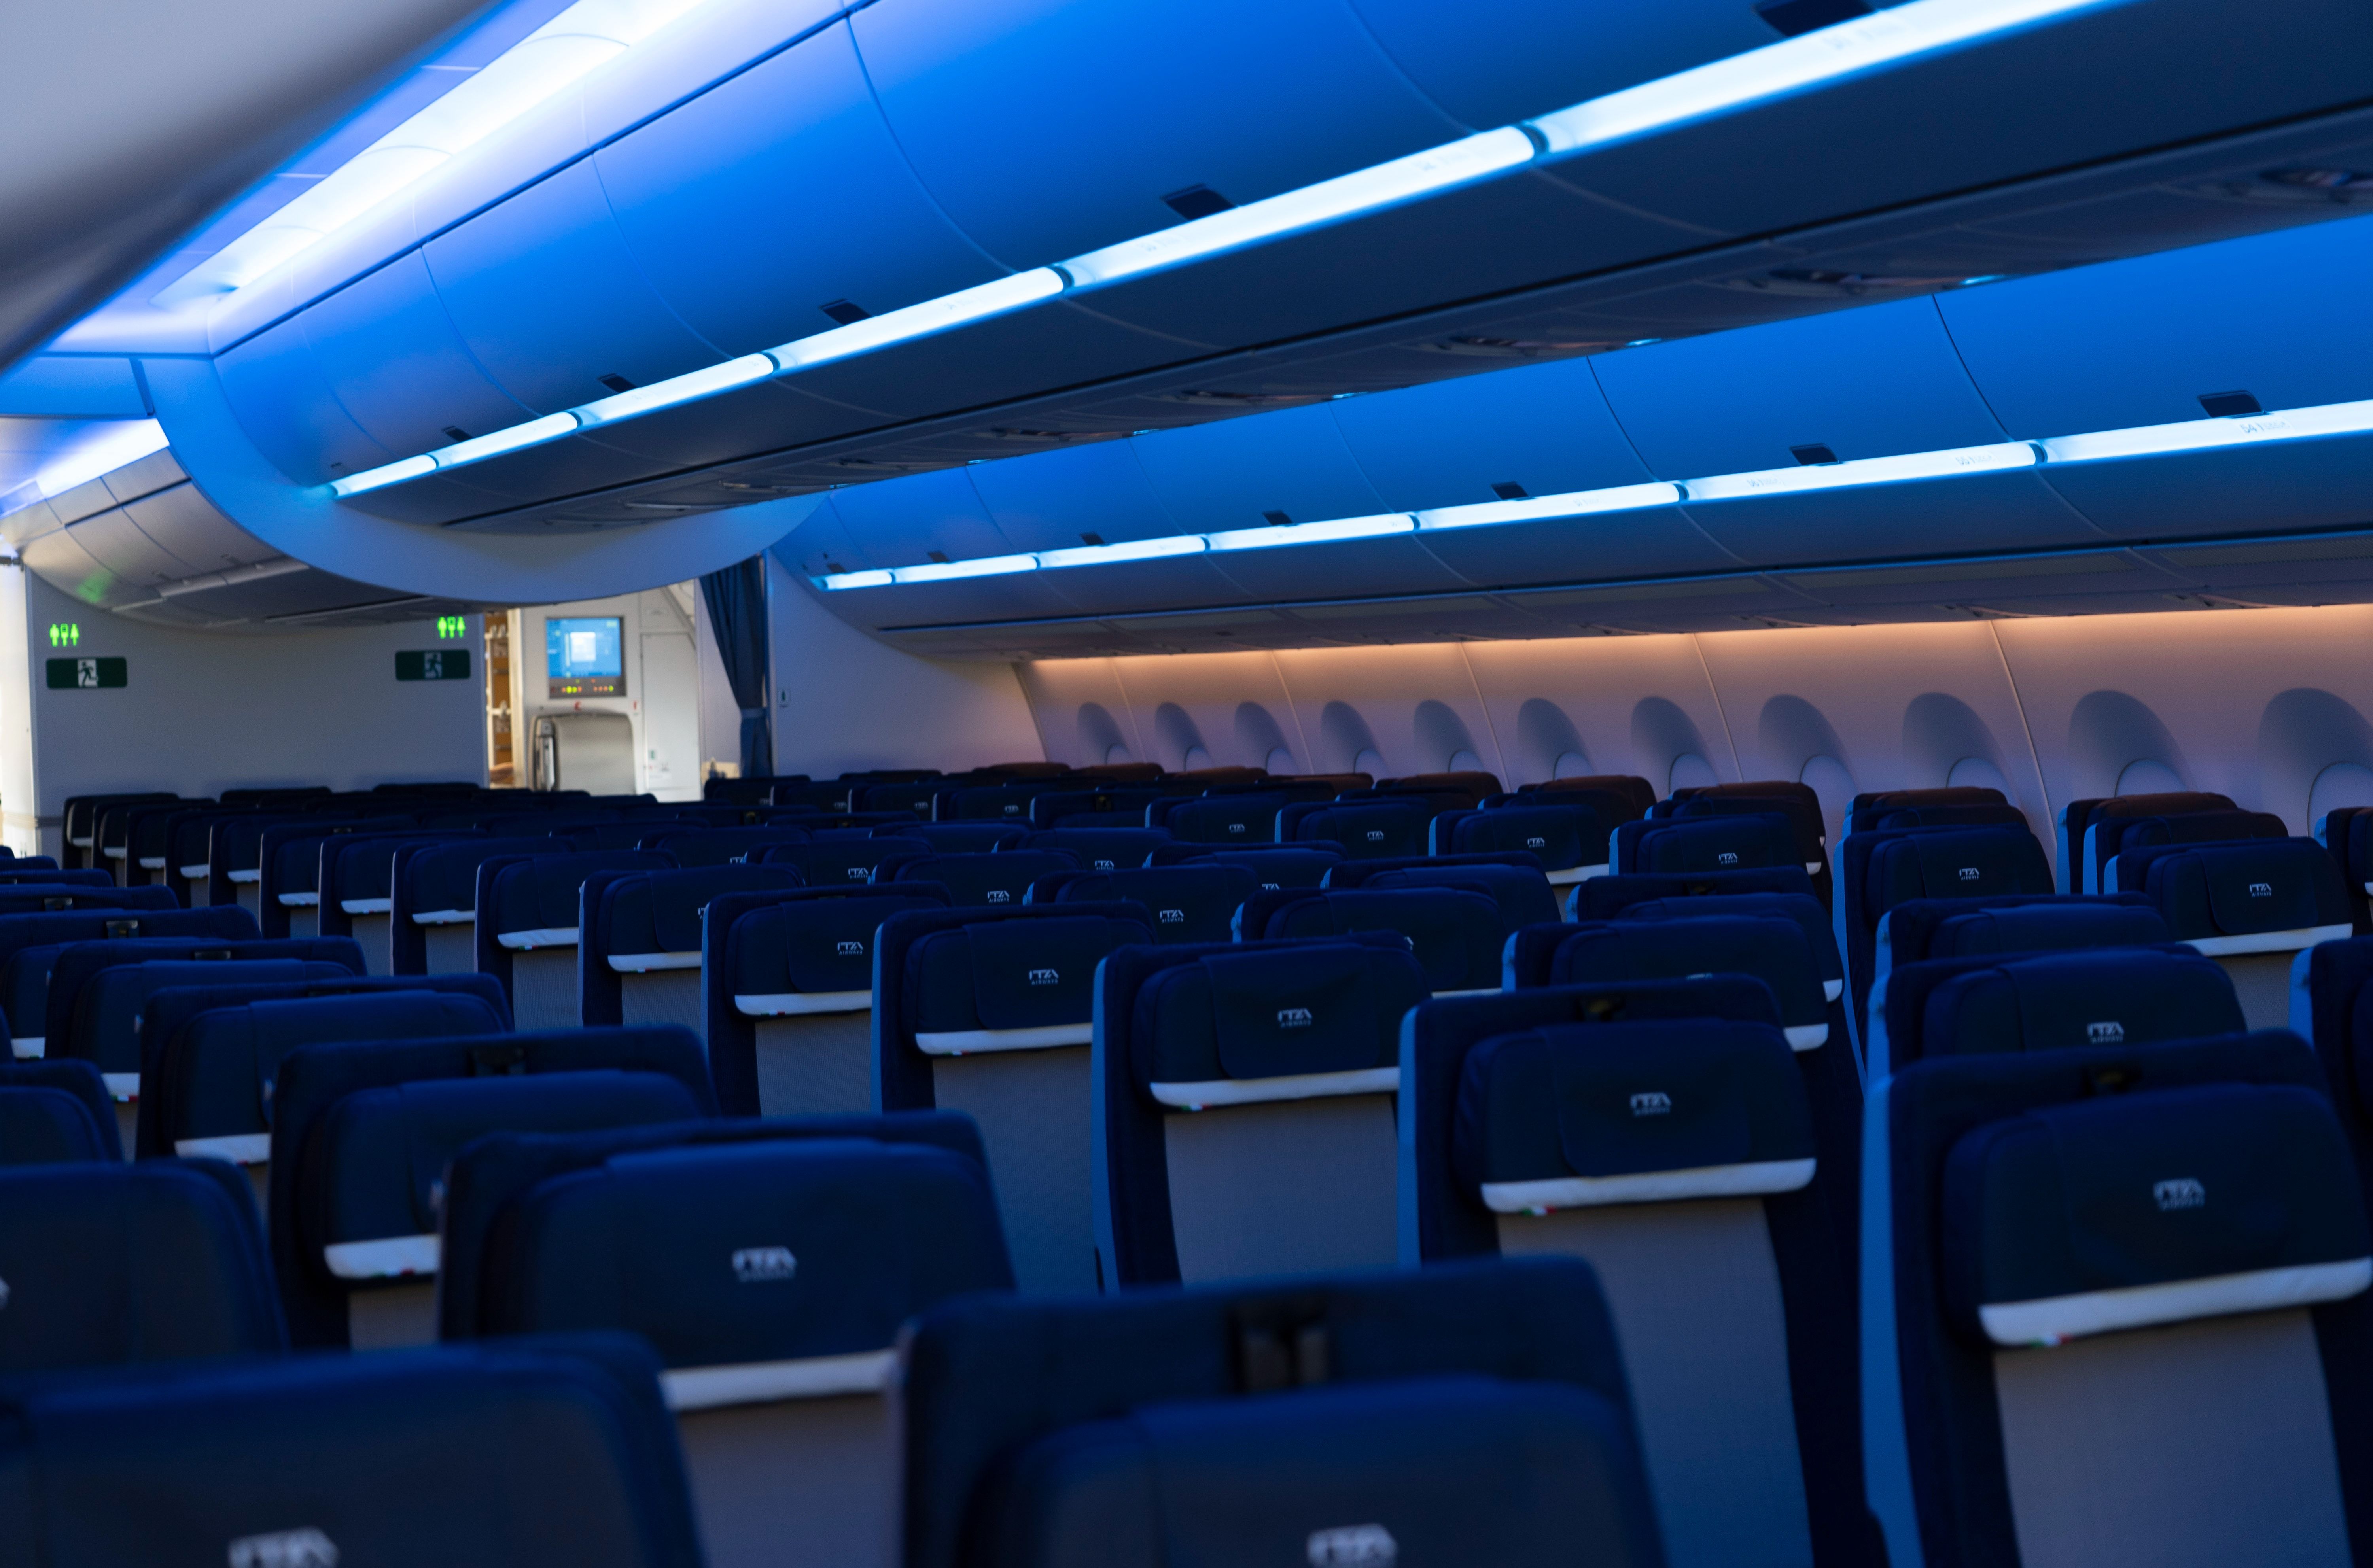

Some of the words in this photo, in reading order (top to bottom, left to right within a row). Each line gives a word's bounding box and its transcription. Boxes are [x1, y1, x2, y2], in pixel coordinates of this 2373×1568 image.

[1719, 853, 1738, 861] ITA
[1959, 868, 1979, 877] ITA
[2250, 883, 2271, 893] ITA
[987, 890, 1010, 899] ITA
[1160, 910, 1184, 919] ITA
[837, 942, 863, 951] ITA
[1029, 969, 1059, 980] ITA
[1278, 1008, 1312, 1021] ITA
[2087, 1021, 2124, 1037] ITA
[1629, 1092, 1672, 1108] ITA
[2153, 1178, 2205, 1199] ITA
[732, 1246, 797, 1271] ITA
